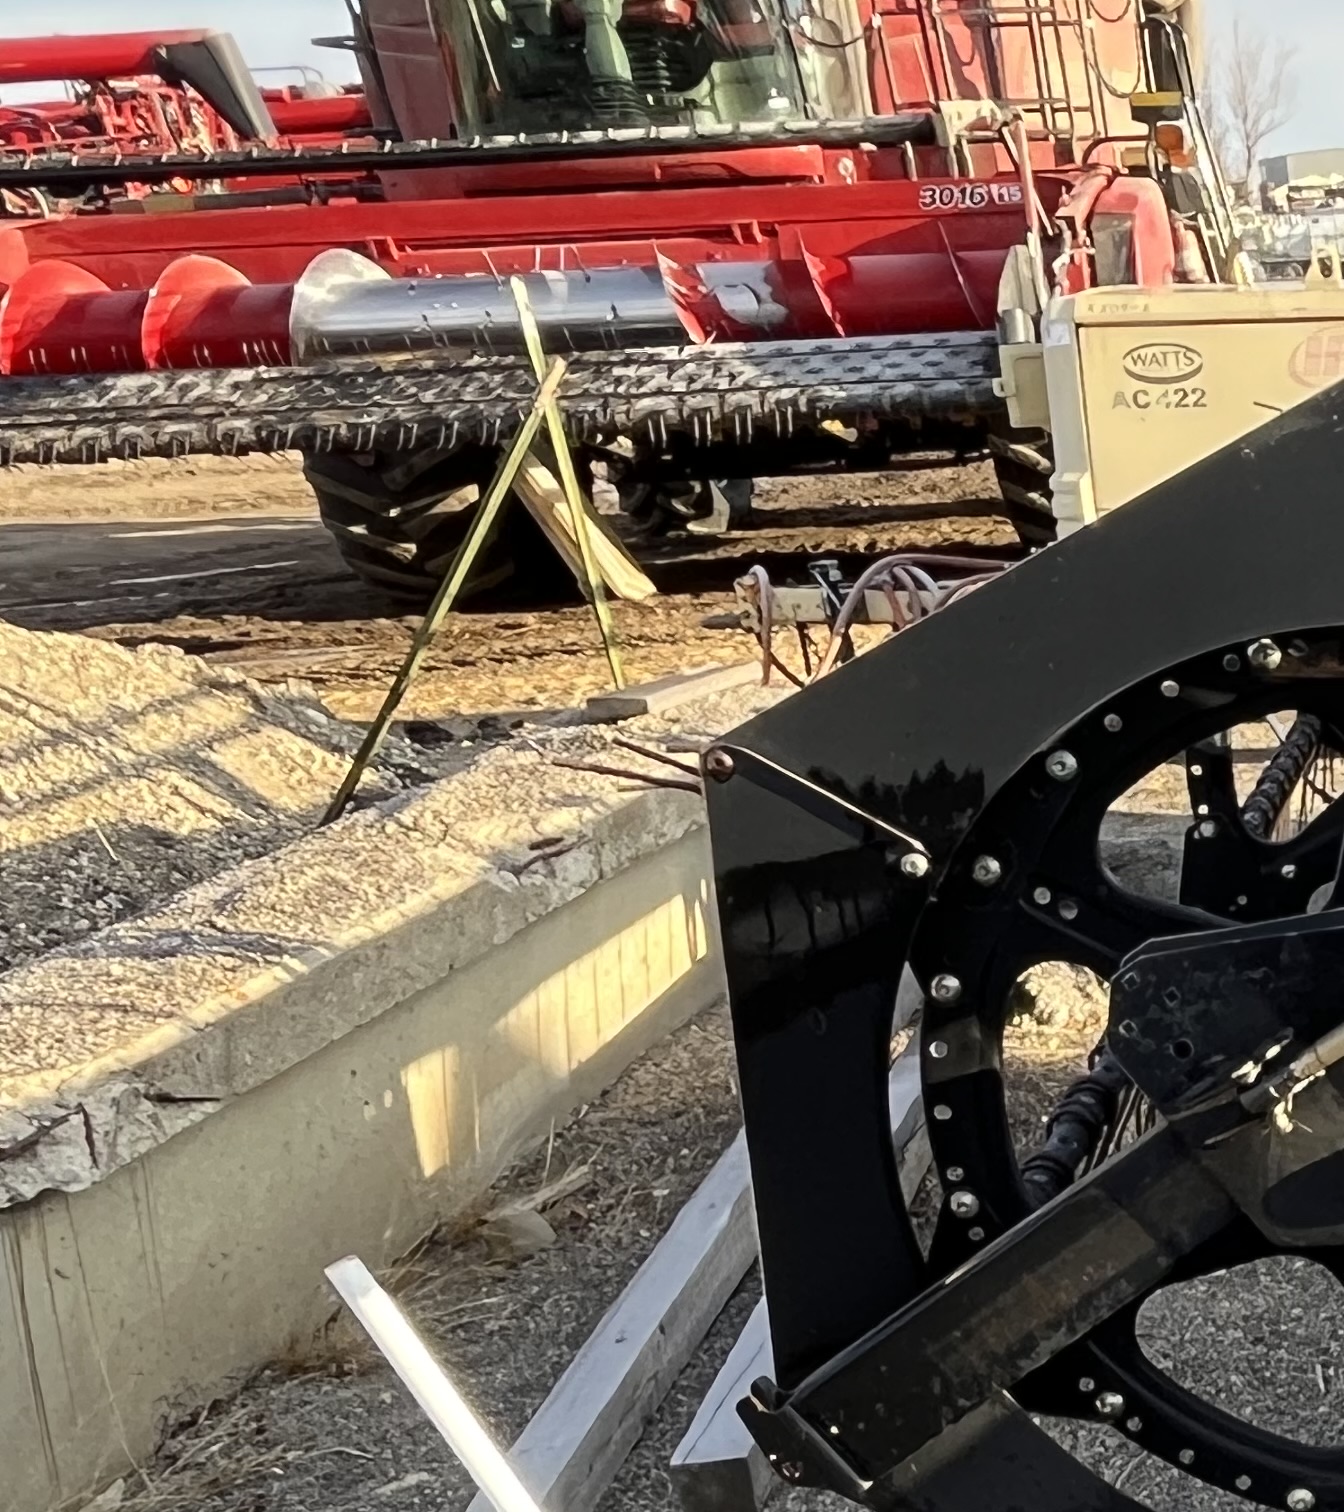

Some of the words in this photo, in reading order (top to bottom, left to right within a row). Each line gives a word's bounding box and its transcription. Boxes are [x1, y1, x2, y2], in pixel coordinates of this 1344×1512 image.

[919, 184, 988, 210] 3016
[1131, 351, 1195, 368] WATTS
[1112, 390, 1151, 409] AC
